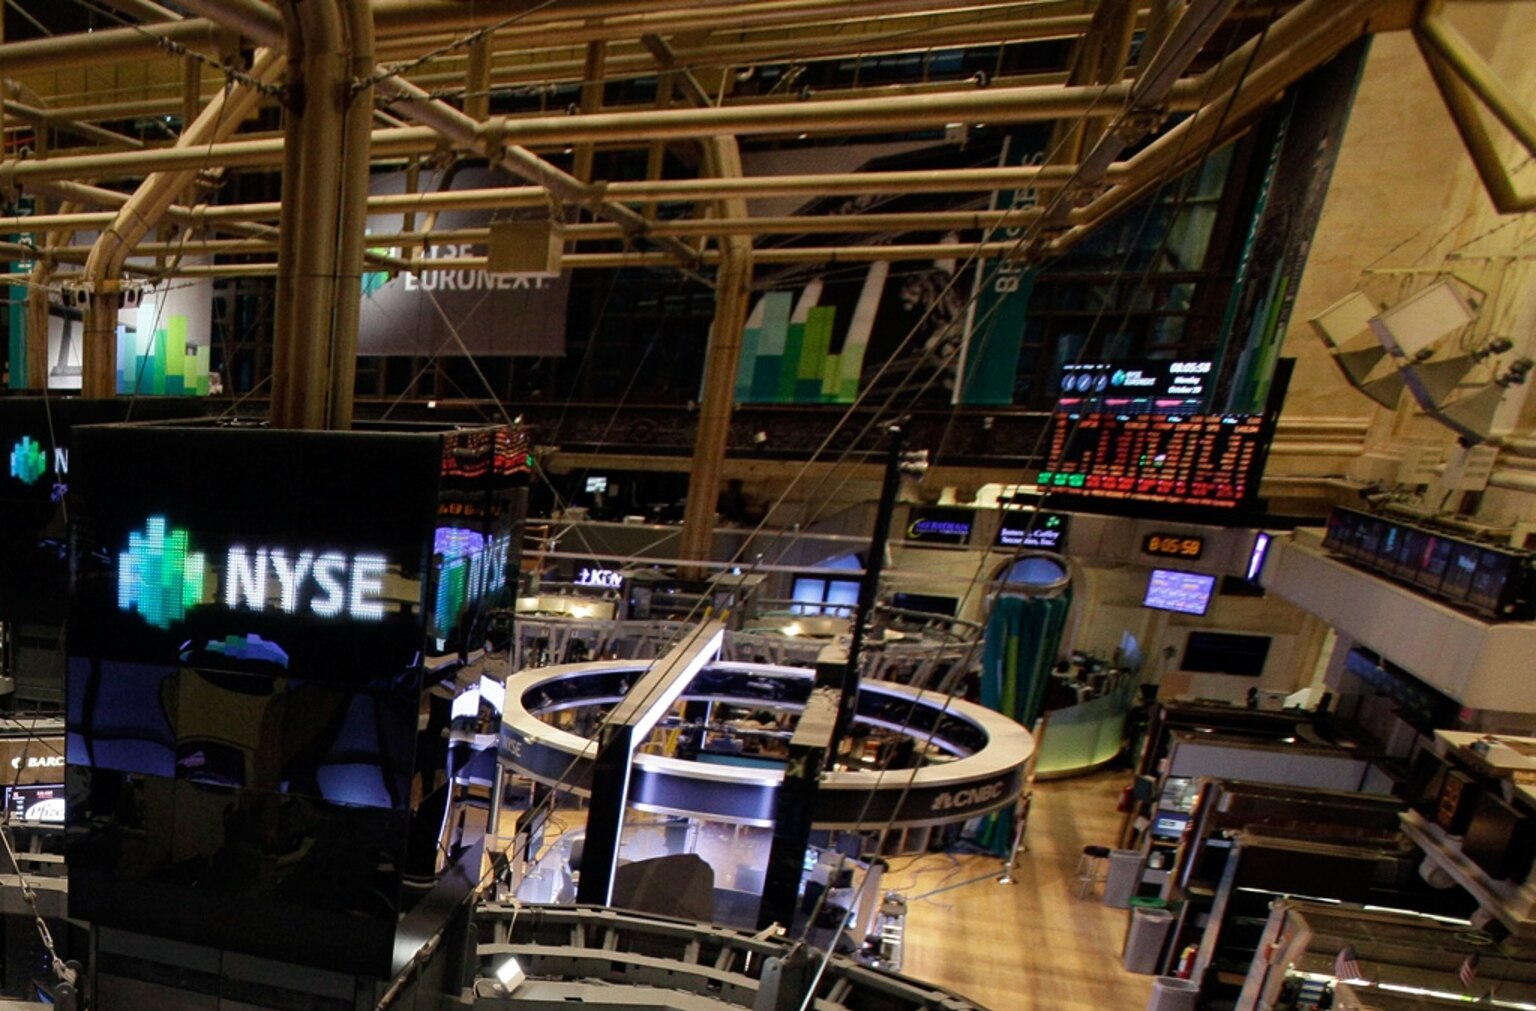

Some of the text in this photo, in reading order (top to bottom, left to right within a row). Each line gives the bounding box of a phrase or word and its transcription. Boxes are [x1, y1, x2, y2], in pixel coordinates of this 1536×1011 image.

[226, 547, 387, 621] NYSE
[953, 781, 1005, 808] CNBC
[30, 804, 65, 820] Pfize
